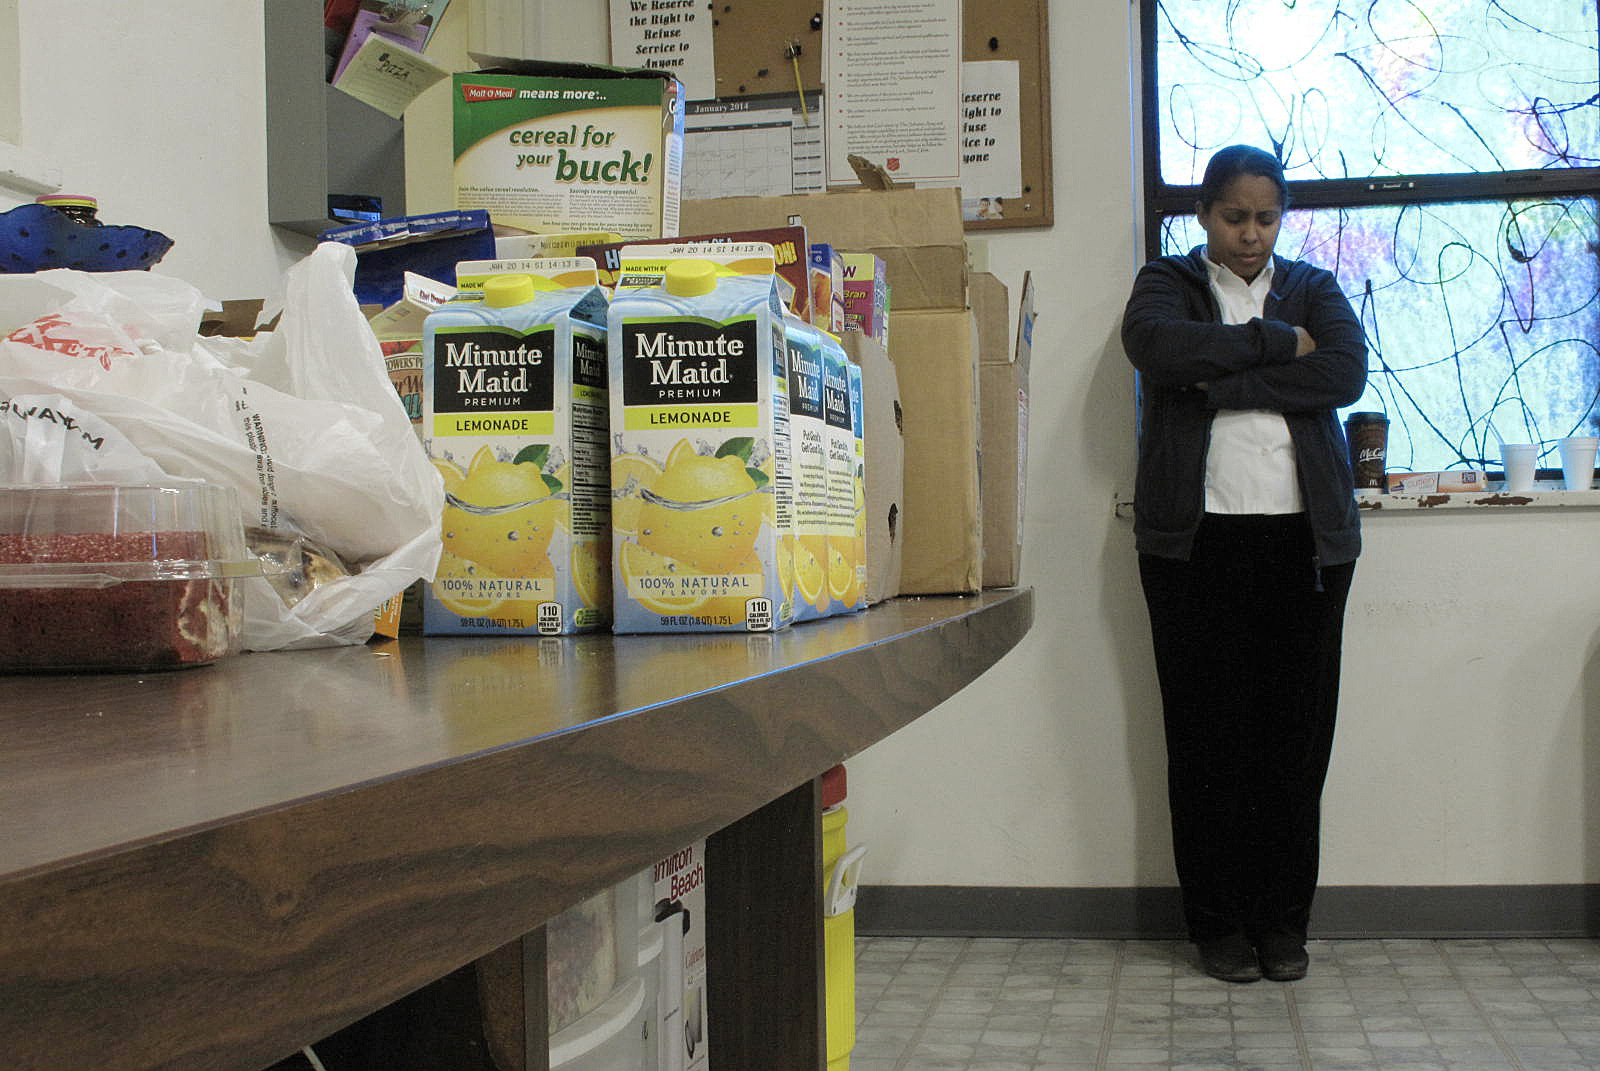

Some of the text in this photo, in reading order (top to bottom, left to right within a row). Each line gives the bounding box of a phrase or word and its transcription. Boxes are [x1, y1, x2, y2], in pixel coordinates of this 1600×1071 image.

[630, 0, 694, 11] We Reserve
[630, 13, 695, 26] the Right to
[644, 29, 681, 40] Refuse
[636, 42, 689, 54] Service to
[642, 58, 685, 69] Anyone
[519, 89, 560, 99] means
[695, 102, 749, 113] January 2014
[991, 106, 1001, 116] to
[510, 124, 616, 147] cereal for
[985, 137, 995, 147] to
[517, 149, 653, 182] your buck!
[635, 332, 744, 358] Minute
[445, 343, 543, 367] Minute
[790, 349, 821, 379] Minute
[650, 359, 730, 385] Maid
[457, 368, 529, 393] Maid
[659, 389, 721, 399] PREMIUM
[797, 375, 819, 402] Maid
[464, 397, 521, 406] PREMIUM
[826, 388, 846, 414] Maid
[651, 411, 731, 425] LEMONADE
[456, 419, 529, 432] LEMONADE
[443, 580, 543, 591] 100% NATURAL
[640, 576, 750, 589] 100% NATURAL
[462, 591, 521, 599] FLAVORS
[661, 589, 728, 597] FLAVORS
[543, 605, 558, 616] 110
[752, 601, 767, 612] 110
[670, 616, 677, 625] FL
[713, 616, 727, 625] 1.75
[670, 863, 704, 901] Beach
